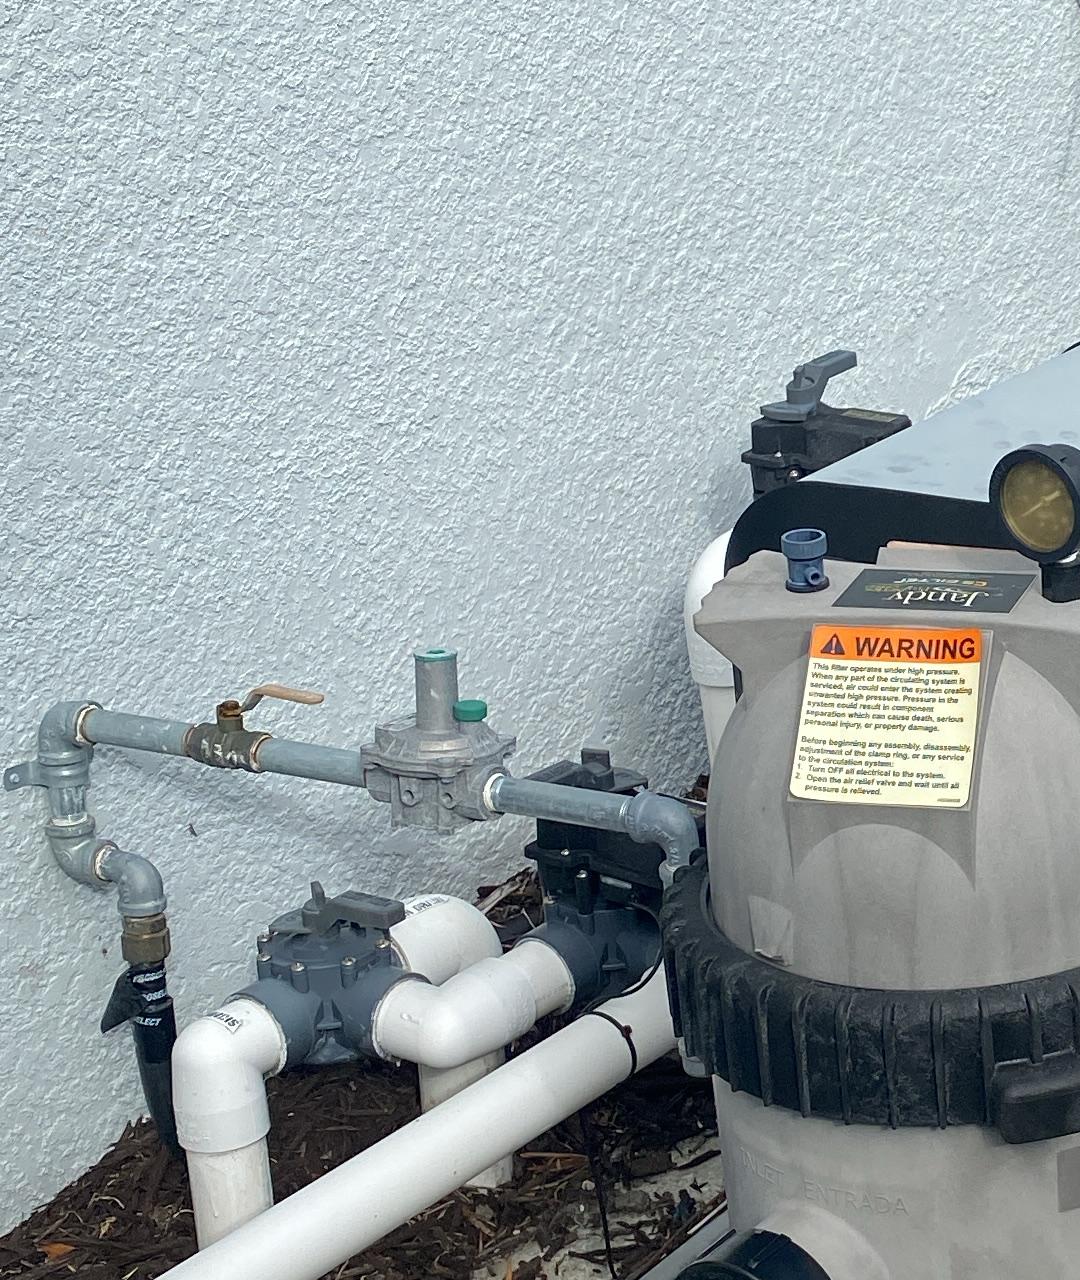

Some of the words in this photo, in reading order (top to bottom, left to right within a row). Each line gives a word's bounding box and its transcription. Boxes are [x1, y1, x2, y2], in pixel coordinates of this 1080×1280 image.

[888, 589, 989, 607] Jandy
[856, 637, 975, 660] WARNING
[908, 668, 924, 676] high
[903, 695, 936, 703] Pressure
[806, 774, 827, 782] Open
[739, 1146, 784, 1185] INLET
[804, 1179, 910, 1216] ENTRADA
